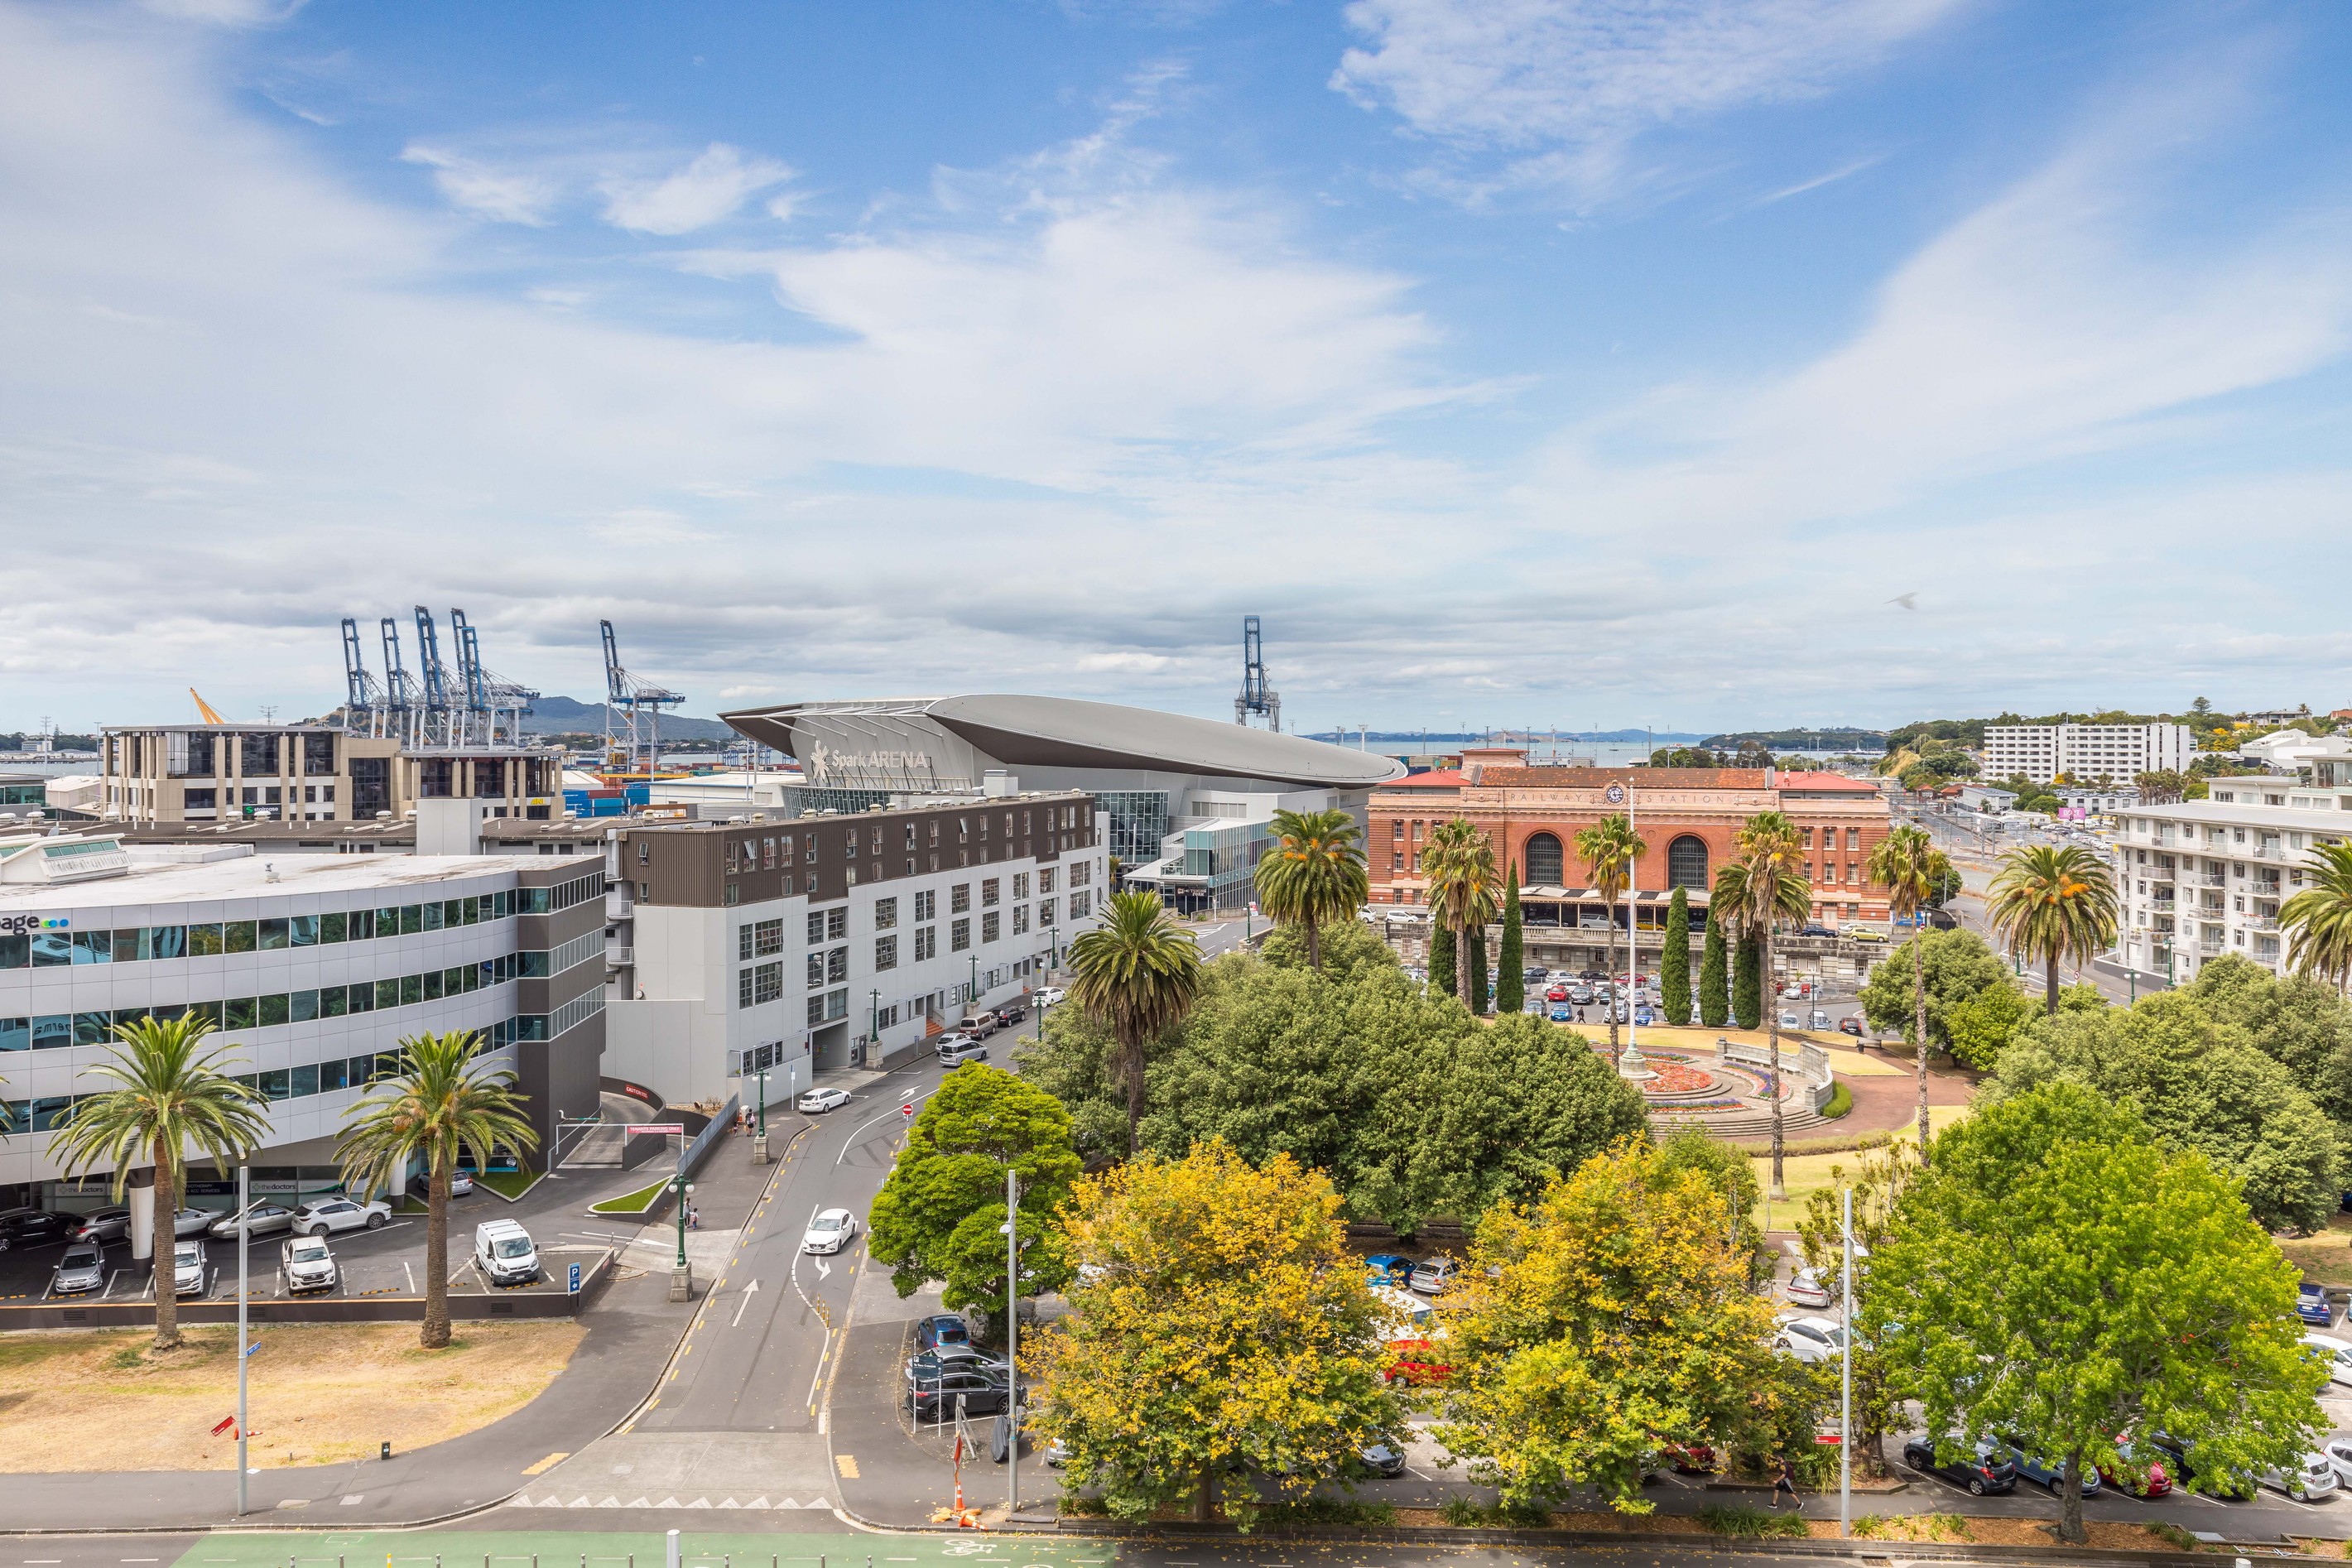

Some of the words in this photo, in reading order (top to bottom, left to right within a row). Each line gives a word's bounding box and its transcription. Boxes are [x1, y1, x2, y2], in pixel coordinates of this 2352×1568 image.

[832, 749, 866, 770] Spark
[869, 750, 928, 768] ARENA
[1511, 792, 1583, 803] RAILWAY
[1647, 795, 1724, 804] STATION
[0, 915, 40, 936] age
[626, 1086, 642, 1096] CAUTION
[572, 1267, 578, 1277] P
